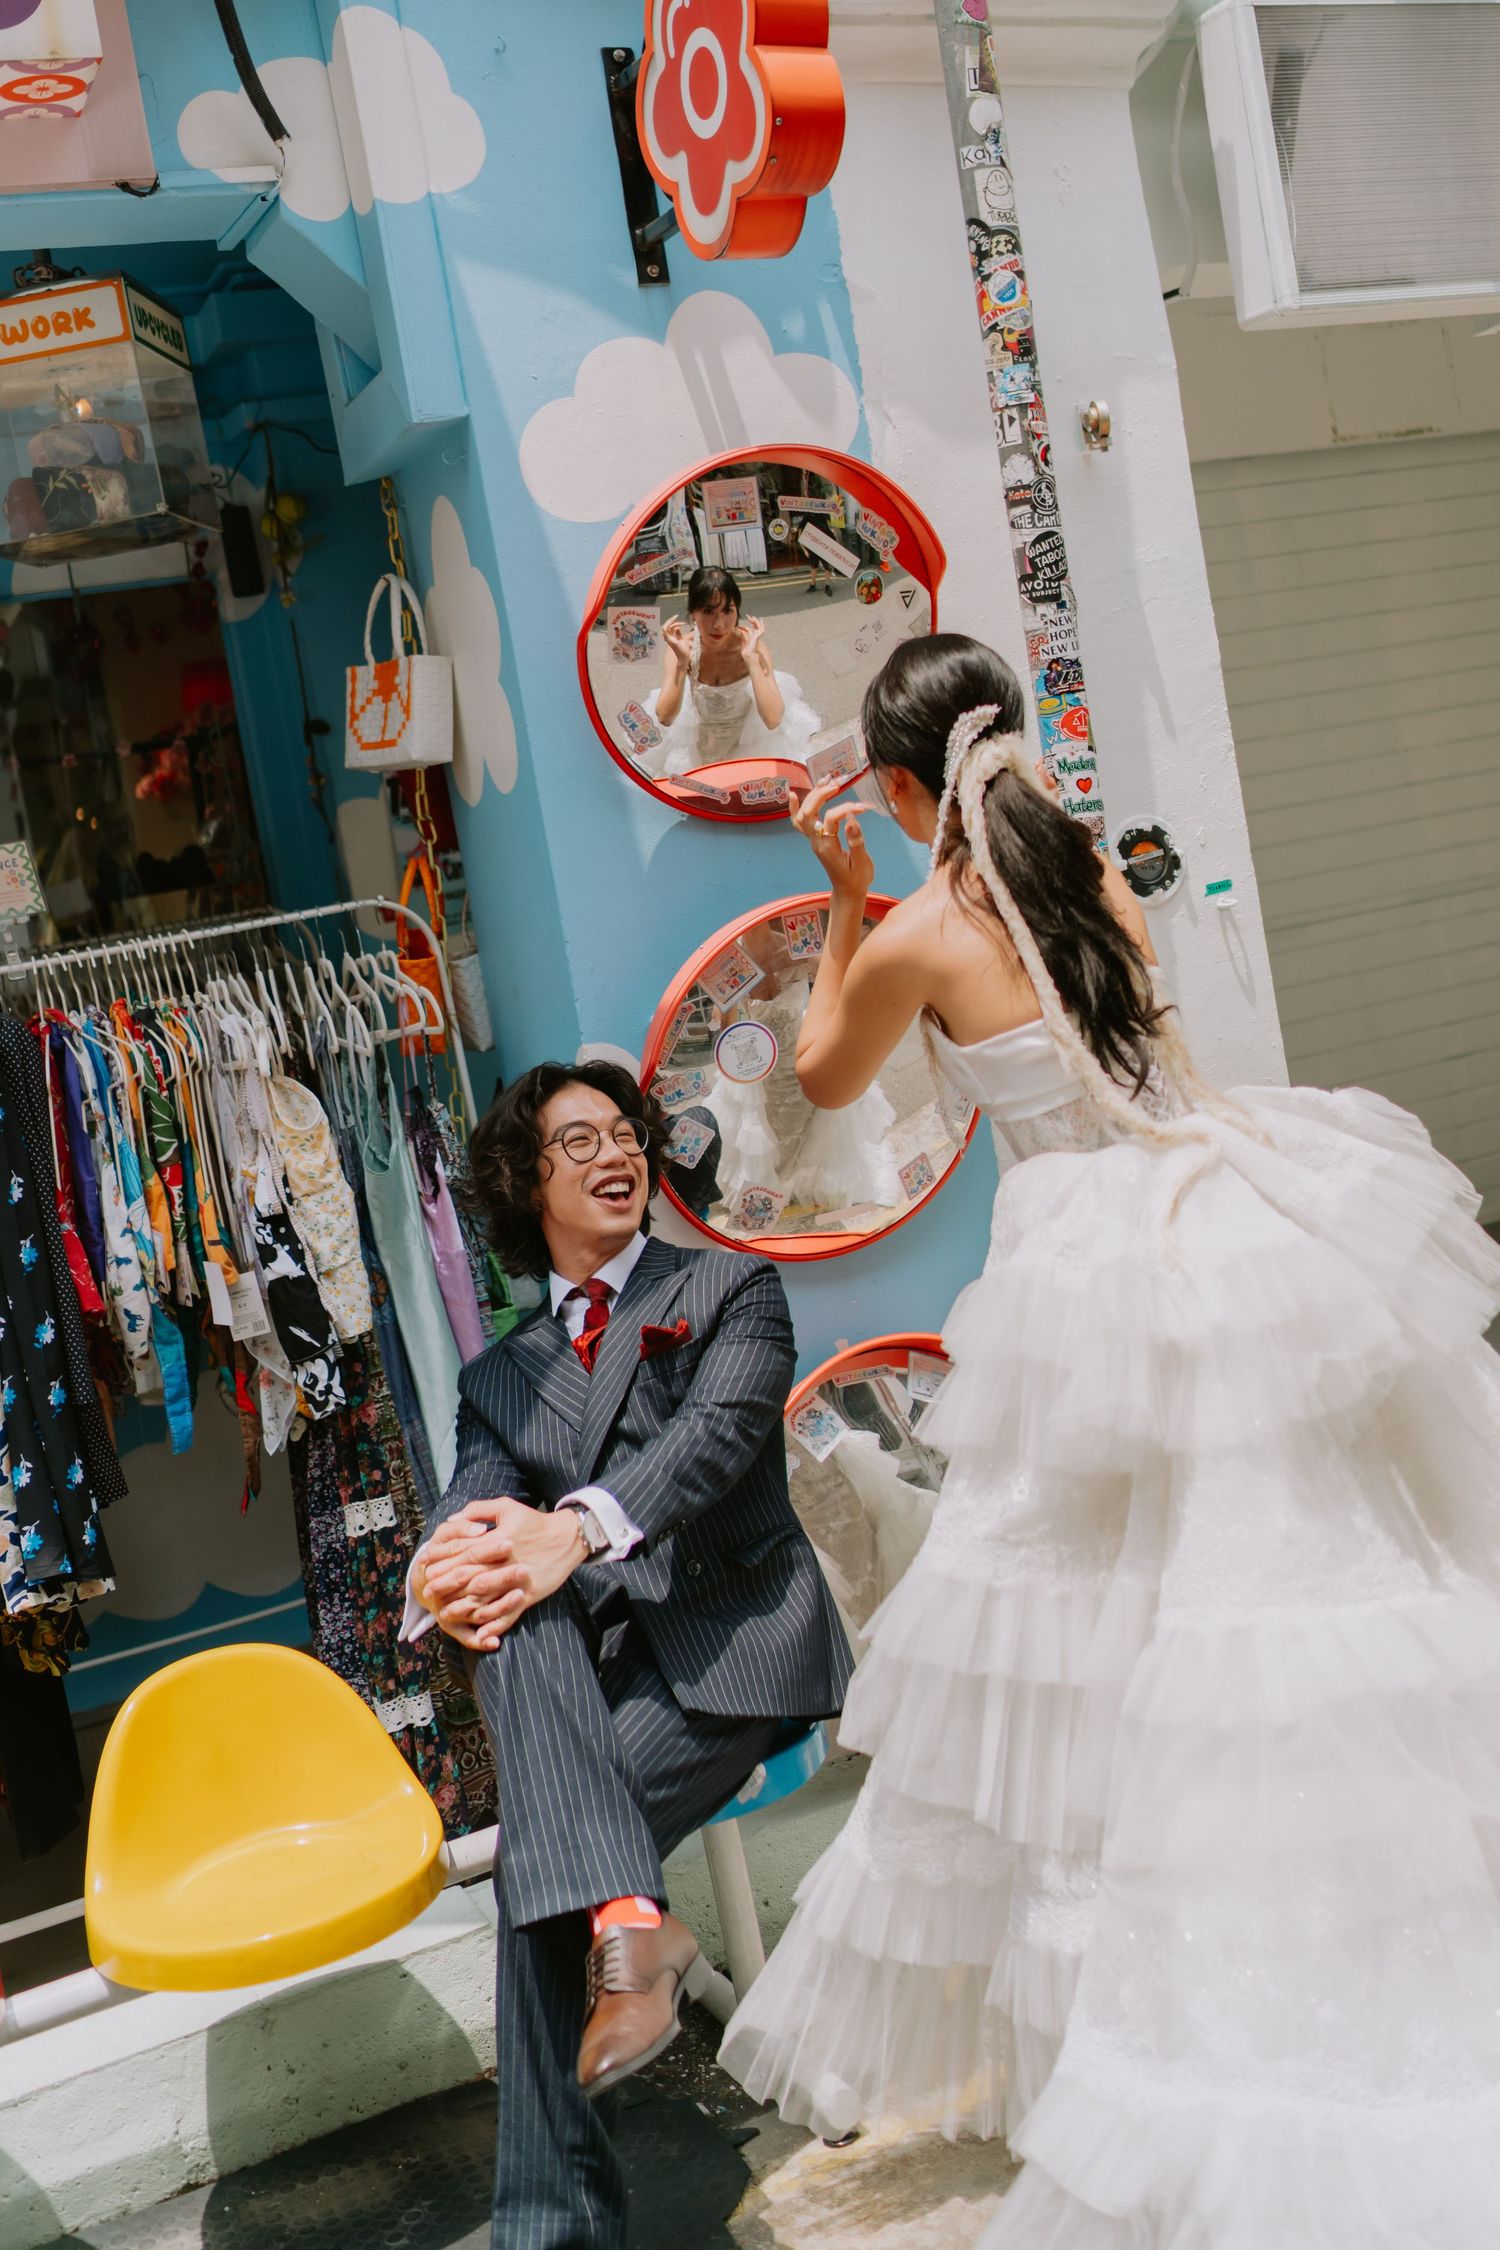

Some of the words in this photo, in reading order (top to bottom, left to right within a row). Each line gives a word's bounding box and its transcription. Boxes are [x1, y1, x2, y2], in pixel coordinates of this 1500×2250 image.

[0, 306, 96, 346] WORK
[1014, 513, 1033, 528] THE
[1021, 580, 1058, 592] AVOID
[1032, 588, 1060, 597] SUBJECT
[1049, 615, 1073, 628] NEW
[1050, 628, 1077, 642] HOPE
[1041, 643, 1067, 656] NEW
[1062, 796, 1104, 816] Haters
